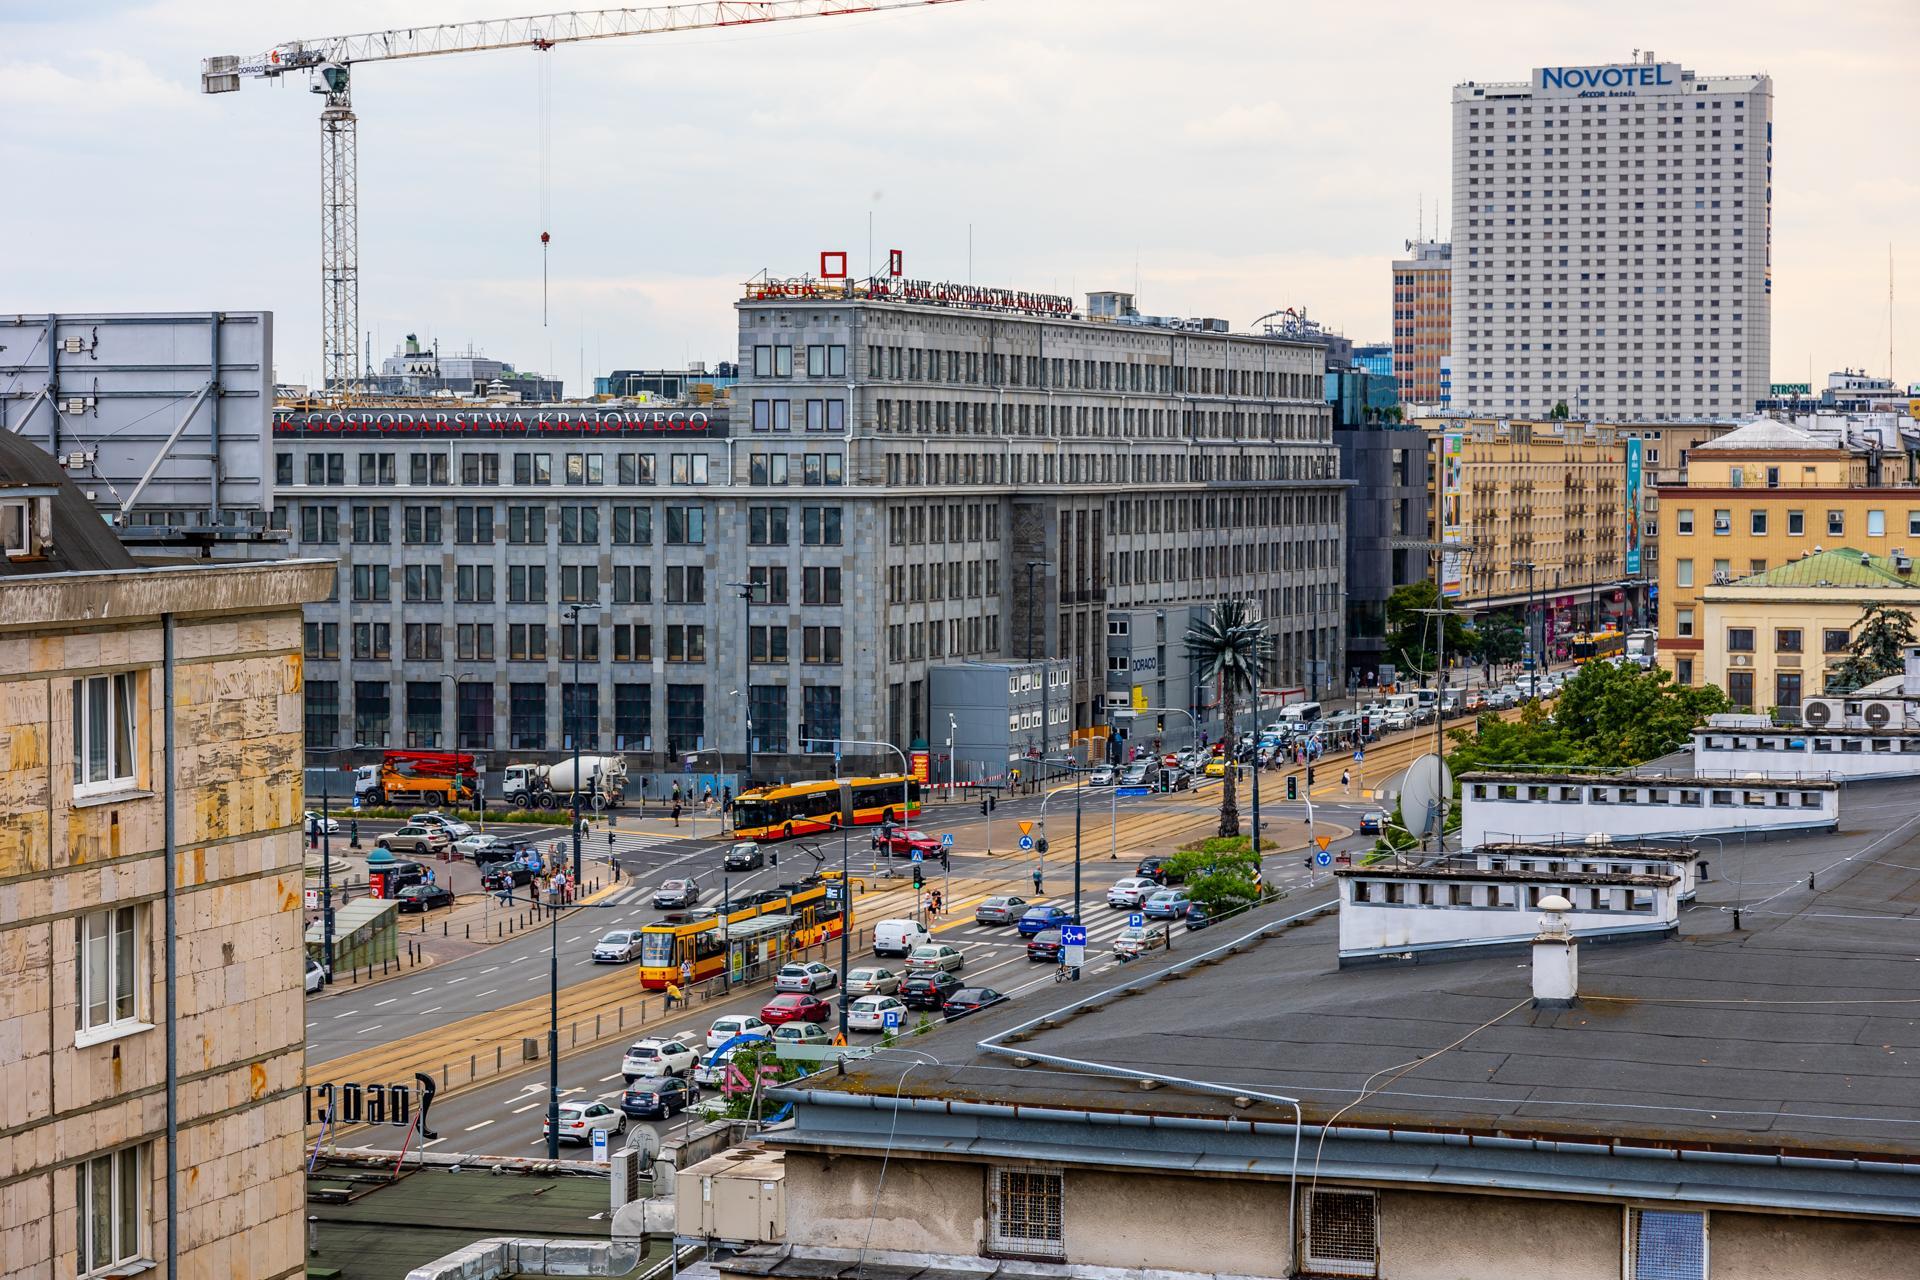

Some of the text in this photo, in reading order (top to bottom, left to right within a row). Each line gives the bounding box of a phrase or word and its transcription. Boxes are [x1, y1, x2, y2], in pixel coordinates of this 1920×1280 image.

[238, 65, 264, 74] DORACO
[1542, 64, 1673, 89] NOVOTEL
[766, 277, 817, 296] BGK
[902, 278, 932, 299] BANK
[935, 281, 1015, 307] GOSPODARSTWA
[1017, 290, 1073, 313] KRAJOWEGO
[1771, 383, 1809, 395] ETROPOL
[306, 412, 526, 432] GOSPODARSTWA
[538, 411, 708, 434] KRAJOWEGO
[1132, 656, 1157, 672] DORACO
[1132, 915, 1140, 926] P
[886, 1013, 895, 1026] P
